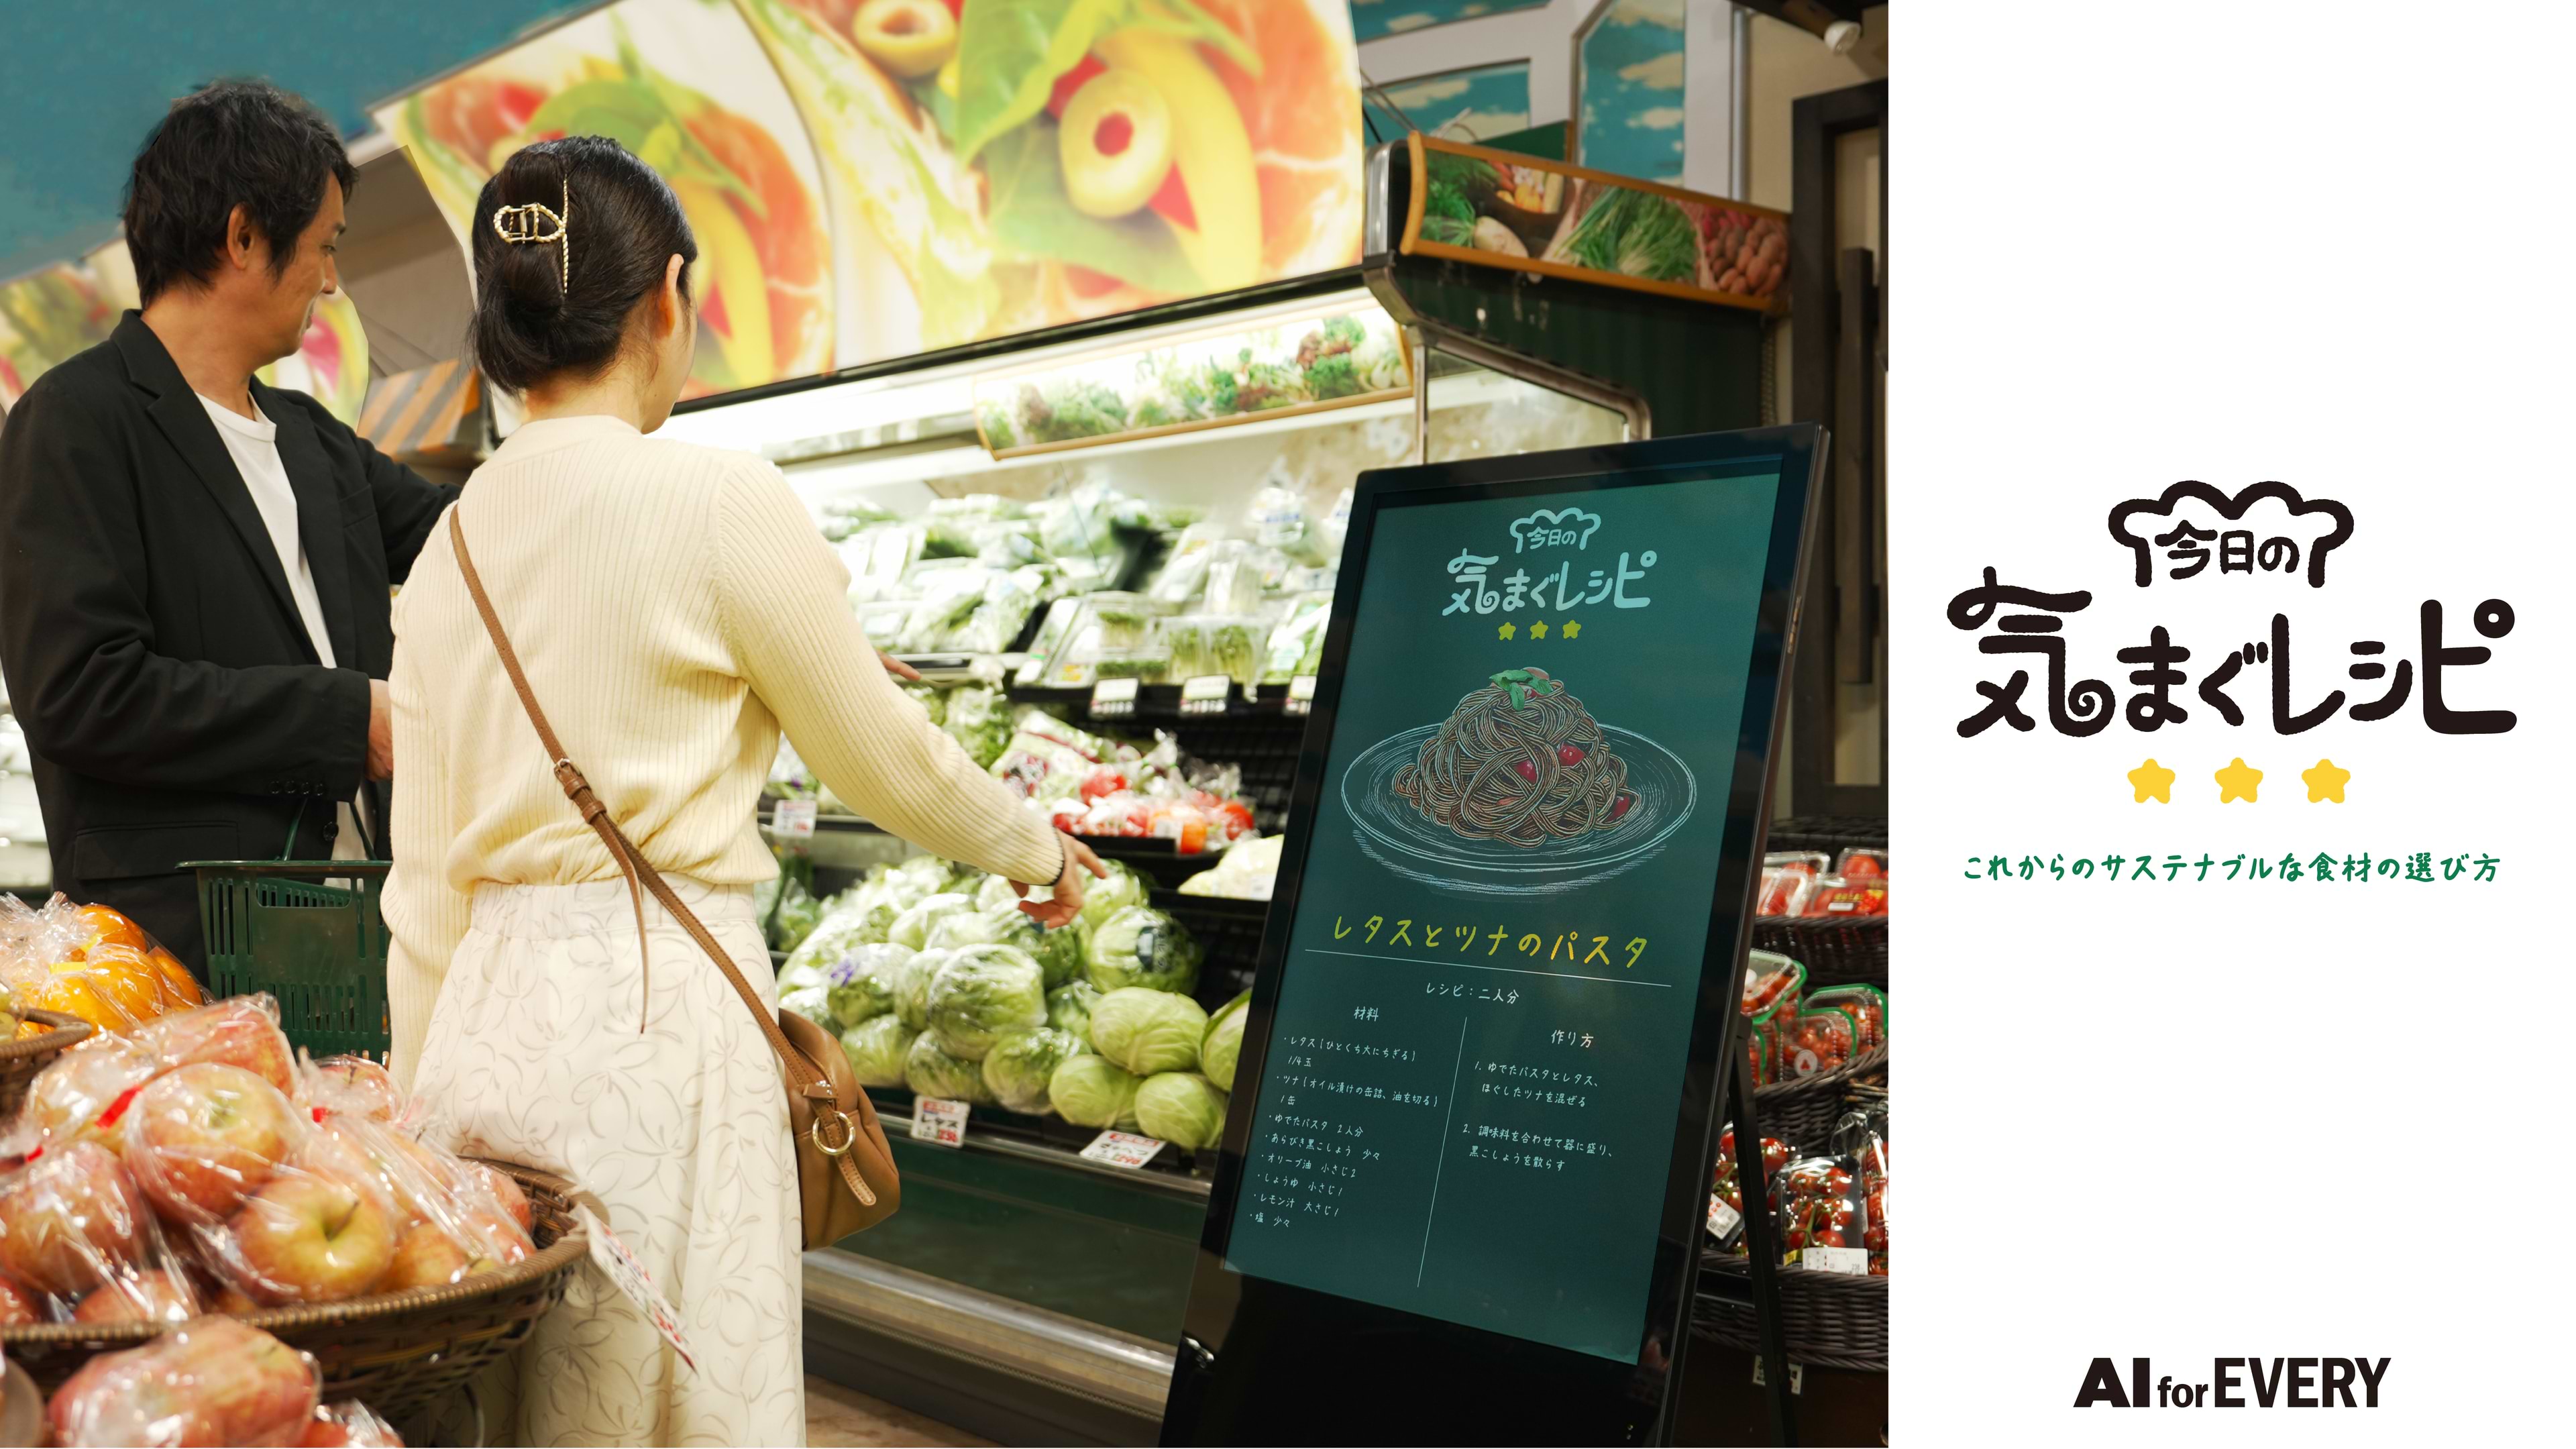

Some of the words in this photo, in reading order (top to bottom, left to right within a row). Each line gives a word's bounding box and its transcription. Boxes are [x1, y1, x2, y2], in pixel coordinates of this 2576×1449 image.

[1526, 525, 1576, 549] 今日の
[1442, 547, 1658, 616] 気まぐレシピ
[1334, 915, 1648, 968] レタスとツナのパスタ
[1426, 982, 1519, 1005] レシピ：二人分
[1353, 1006, 1379, 1022] 材料
[1551, 1029, 1595, 1049] 作り方
[1487, 1061, 1598, 1087] ゆでたパスタとレタス、
[1481, 1083, 1587, 1108] ほぐしたツナを混ぜる
[1336, 1124, 1364, 1138] 2人分
[1478, 1124, 1612, 1157] 調味料を合わせて器に盛り、
[1362, 1149, 1381, 1161] 少々
[1468, 1144, 1565, 1171] 黒こしょうを散らす
[1320, 1163, 1356, 1178] 小さじ2
[1273, 1216, 1291, 1228] 少々
